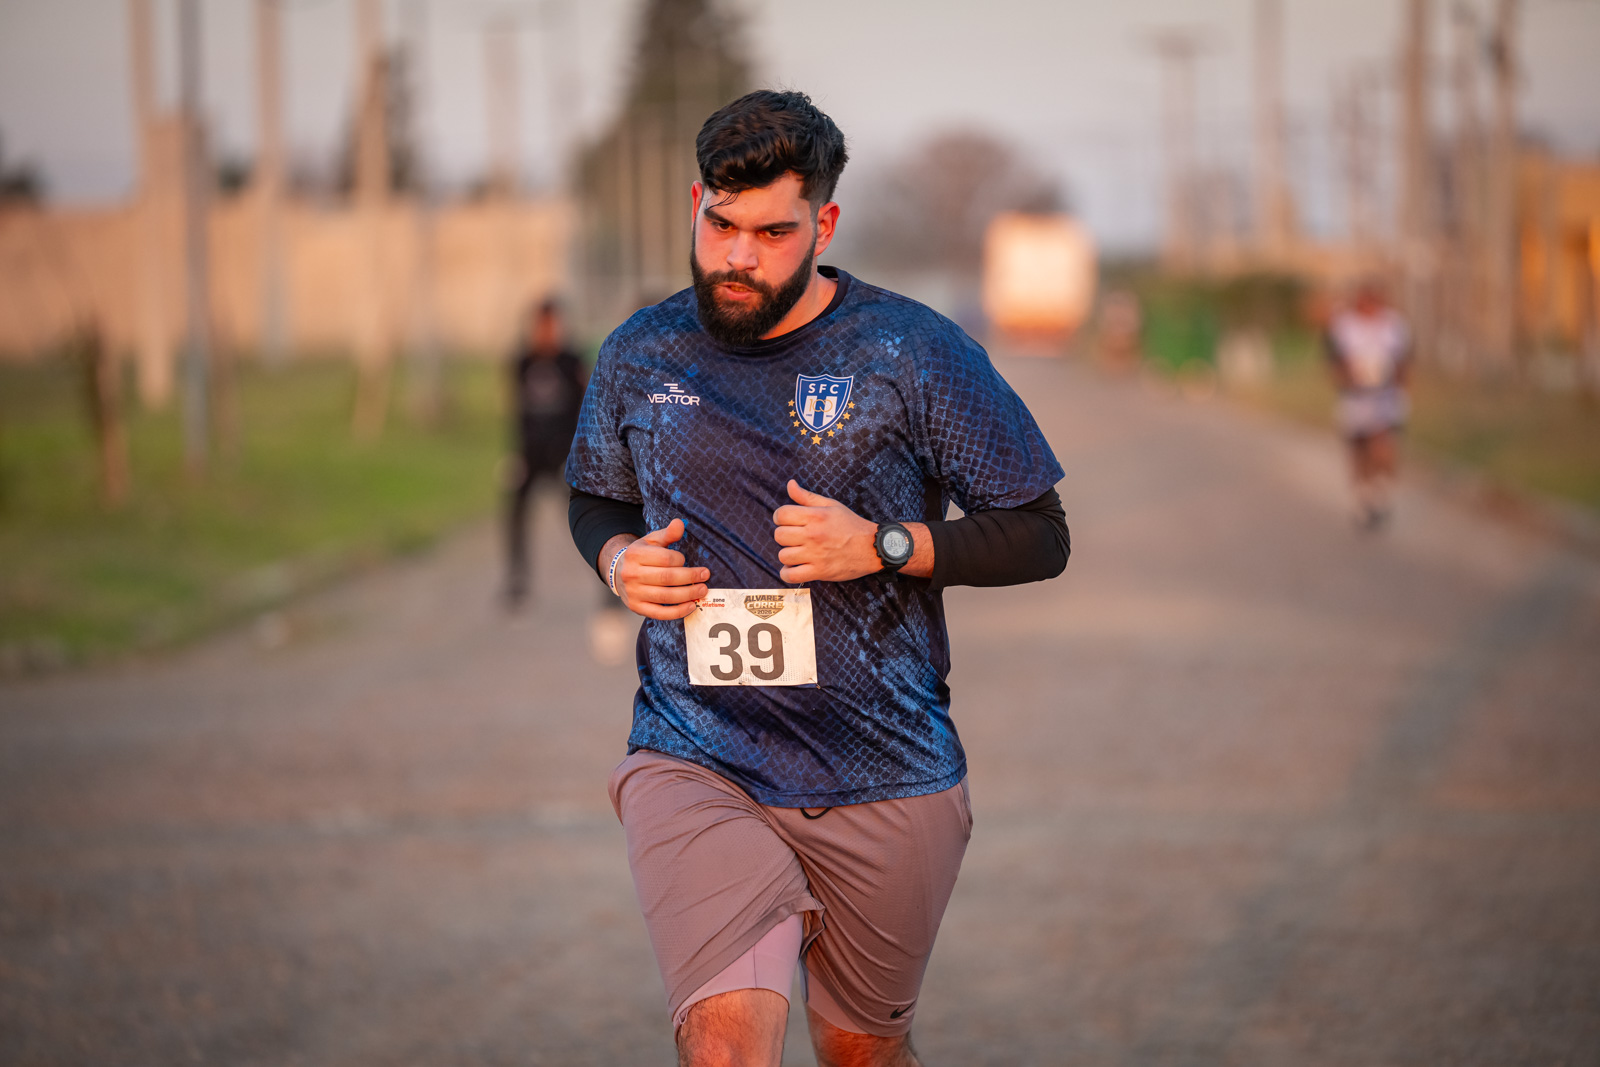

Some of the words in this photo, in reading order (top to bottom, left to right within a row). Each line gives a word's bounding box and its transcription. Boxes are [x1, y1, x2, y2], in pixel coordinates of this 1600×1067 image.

[808, 383, 839, 394] SFC
[647, 394, 700, 406] VEKTOR
[809, 398, 833, 412] 100
[744, 594, 785, 603] ALVAREZ
[746, 601, 783, 609] CORRE
[708, 622, 785, 681] 39
